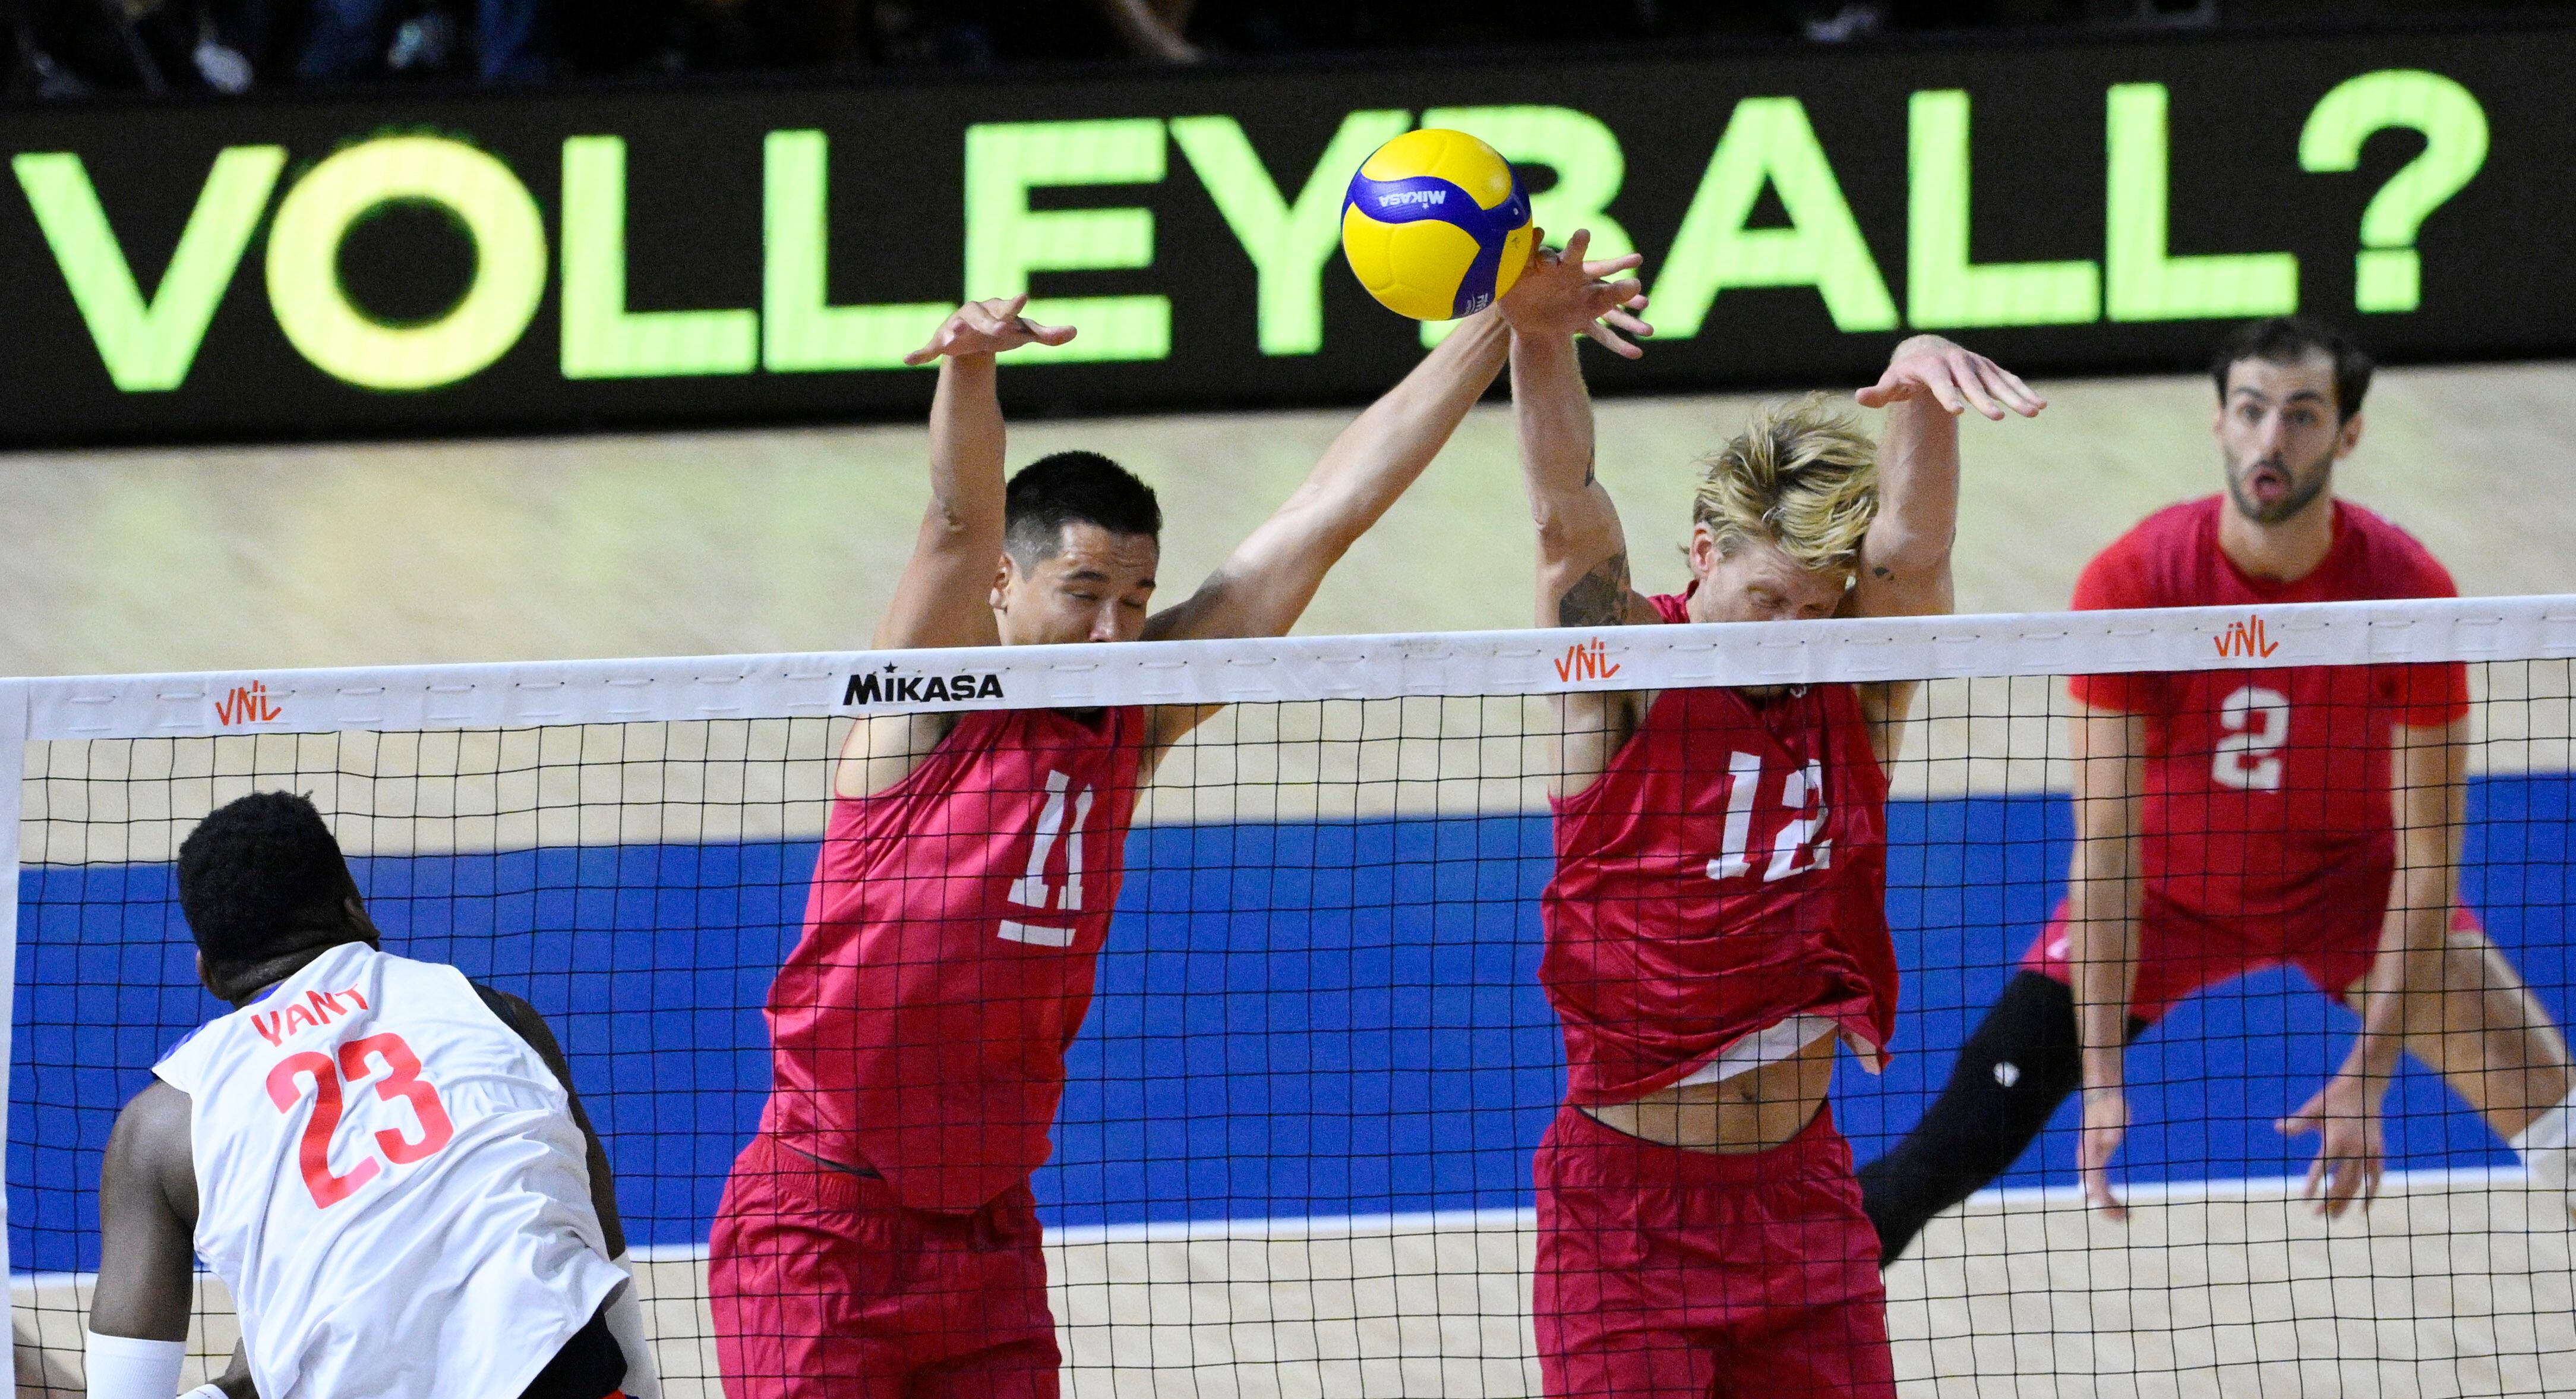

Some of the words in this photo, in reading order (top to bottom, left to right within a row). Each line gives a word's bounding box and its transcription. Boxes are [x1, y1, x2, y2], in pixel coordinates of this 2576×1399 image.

[1554, 636, 1620, 682] VNL
[2213, 614, 2279, 658] VNL
[214, 679, 282, 726] VNL
[2211, 685, 2290, 795] 2
[1006, 769, 1094, 911] 11
[1705, 750, 1833, 883] 12
[250, 983, 370, 1047] YANT
[265, 1032, 455, 1210] 23
